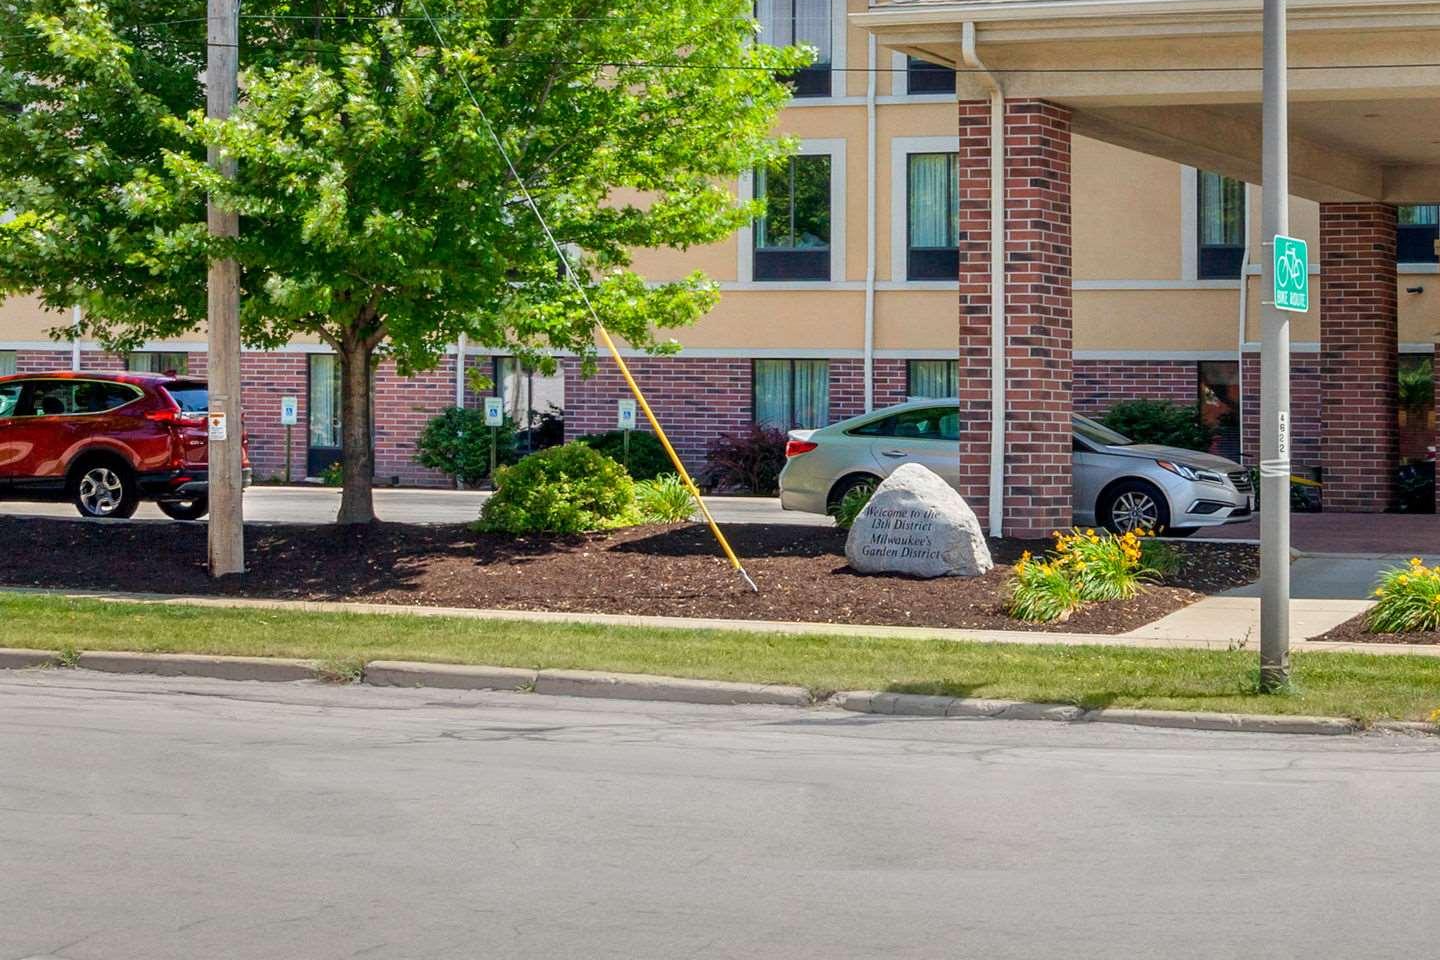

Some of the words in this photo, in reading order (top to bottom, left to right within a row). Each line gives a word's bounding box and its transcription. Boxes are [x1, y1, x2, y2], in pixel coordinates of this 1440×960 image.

[1276, 290, 1288, 304] BIKE
[1290, 291, 1306, 308] ROUTE
[866, 506, 907, 519] Welcome
[910, 509, 921, 518] to
[924, 508, 940, 519] the
[871, 518, 890, 529] 13th
[894, 519, 932, 531] District
[870, 533, 932, 546] Milwaukee's
[862, 545, 898, 557] Garden
[901, 546, 941, 559] District
